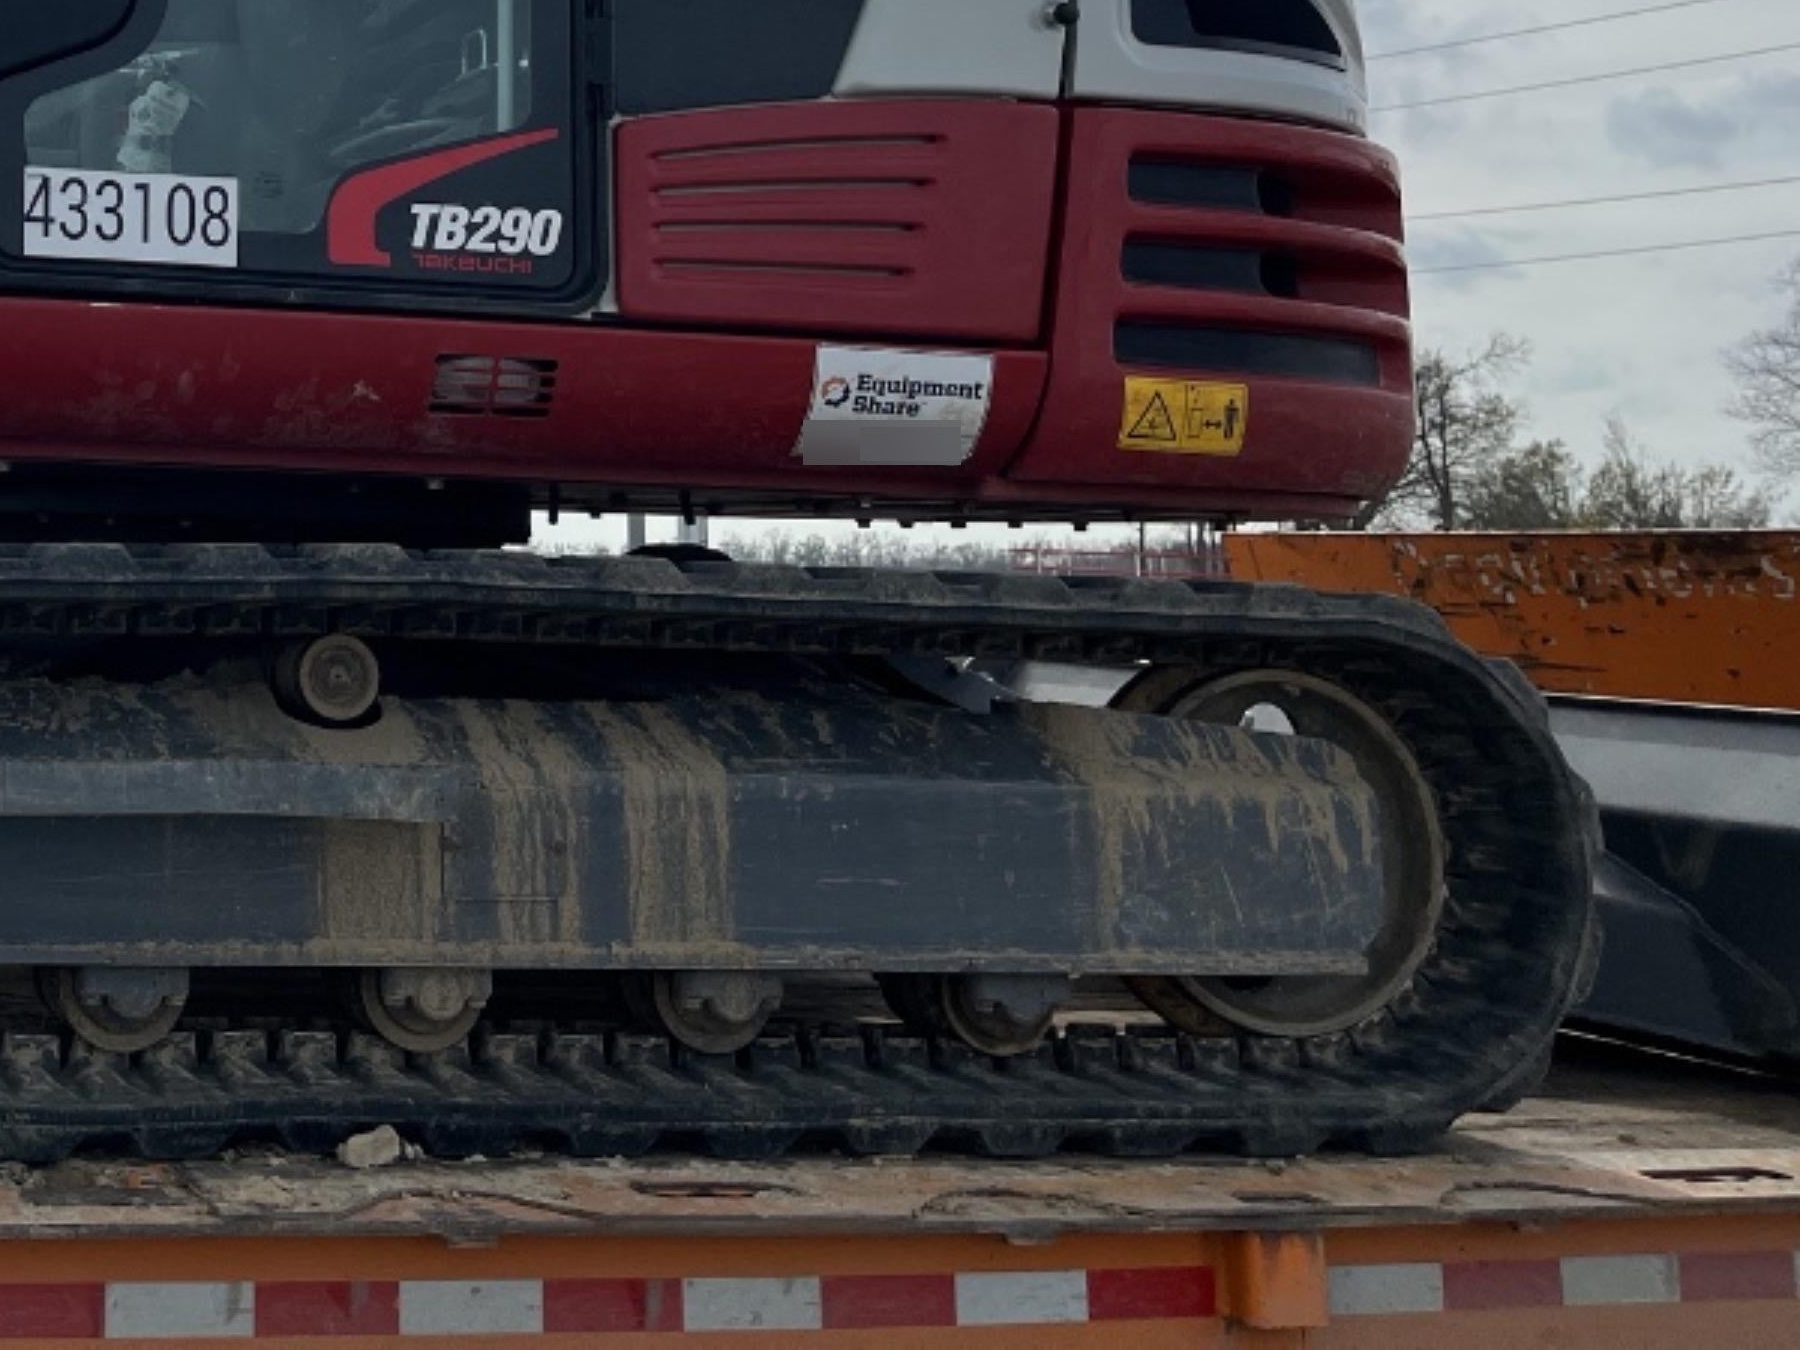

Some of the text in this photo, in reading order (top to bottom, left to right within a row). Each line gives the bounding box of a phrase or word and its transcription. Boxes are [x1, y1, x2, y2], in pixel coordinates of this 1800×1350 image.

[24, 175, 231, 247] 433108
[410, 203, 563, 256] TB290
[413, 254, 533, 275] TAKEUCHI
[856, 373, 984, 399] Equipment
[852, 395, 921, 417] Share
